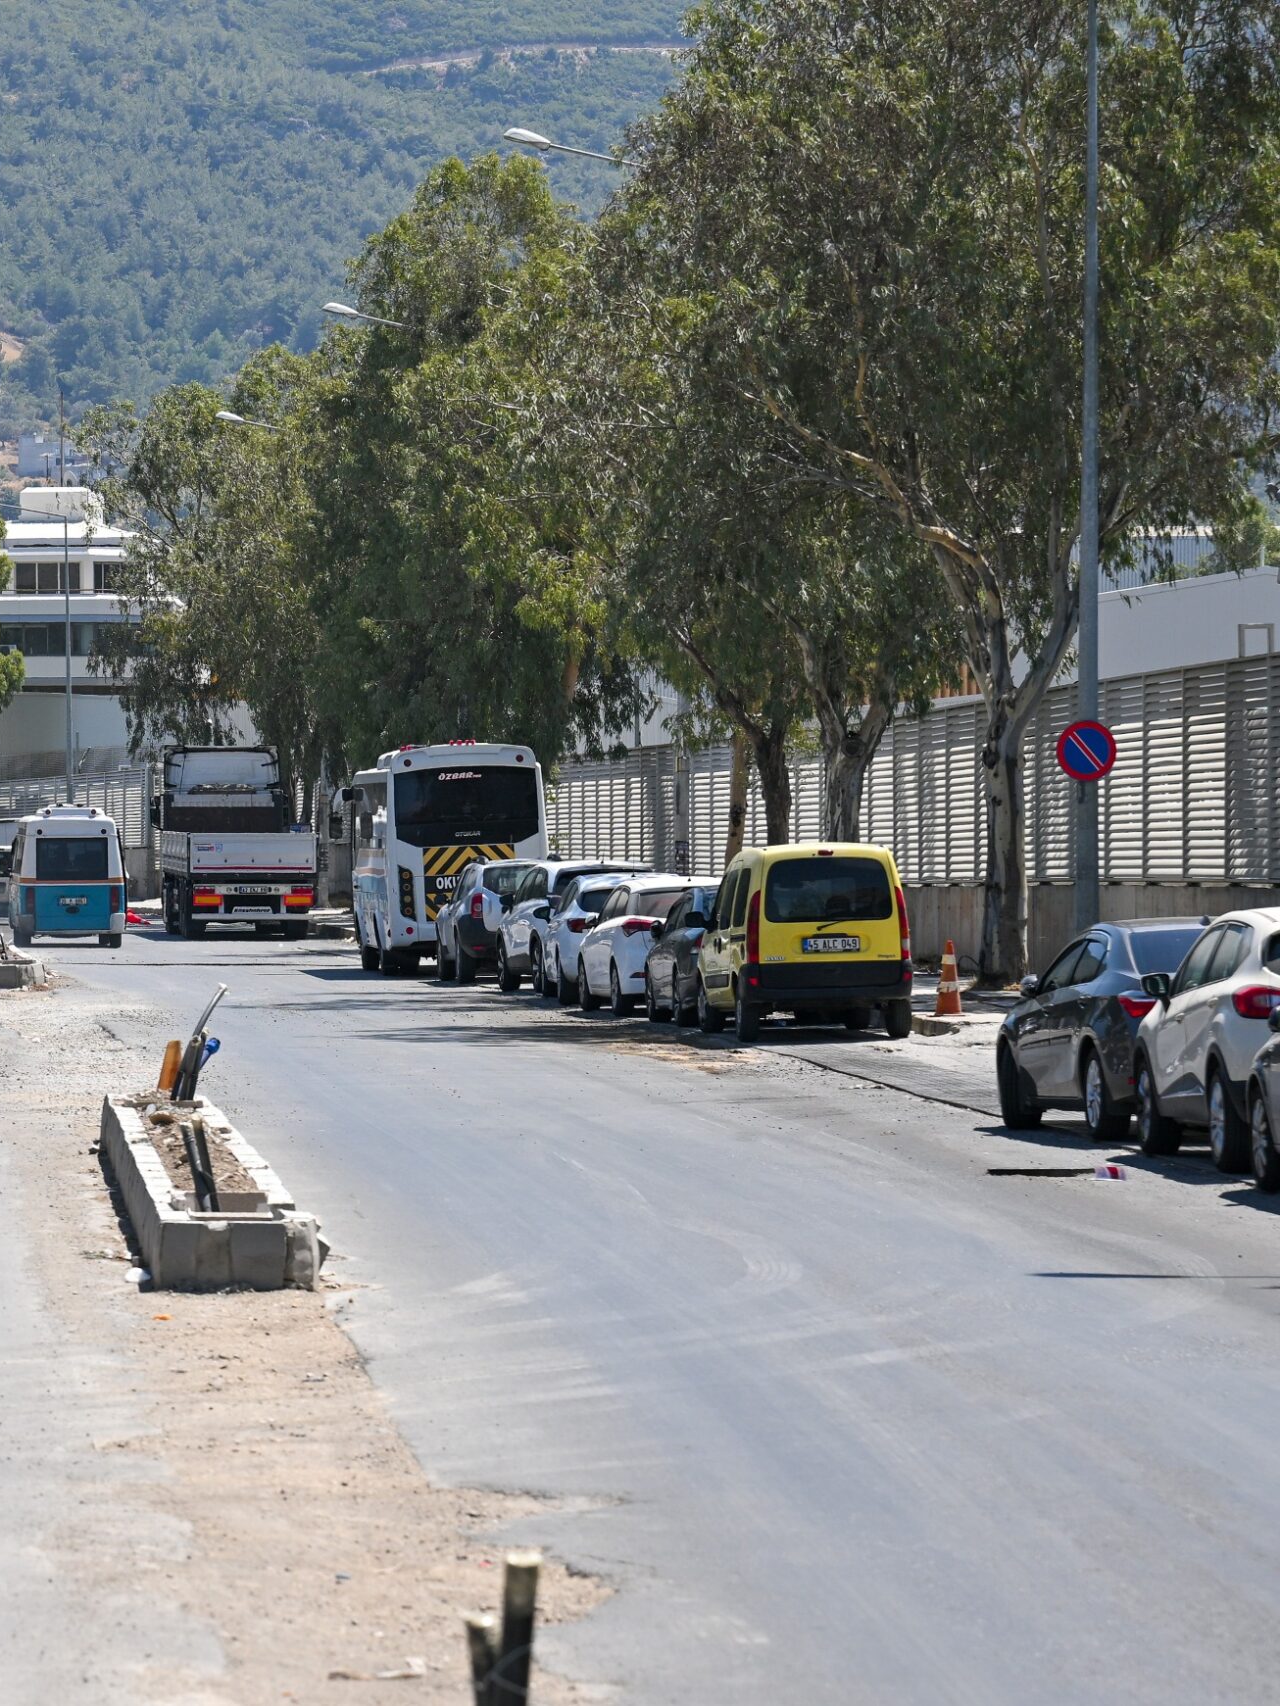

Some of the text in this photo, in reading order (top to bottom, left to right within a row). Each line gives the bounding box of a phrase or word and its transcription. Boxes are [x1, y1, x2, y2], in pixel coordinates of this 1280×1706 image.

[809, 938, 858, 949] 45 ALC 049
